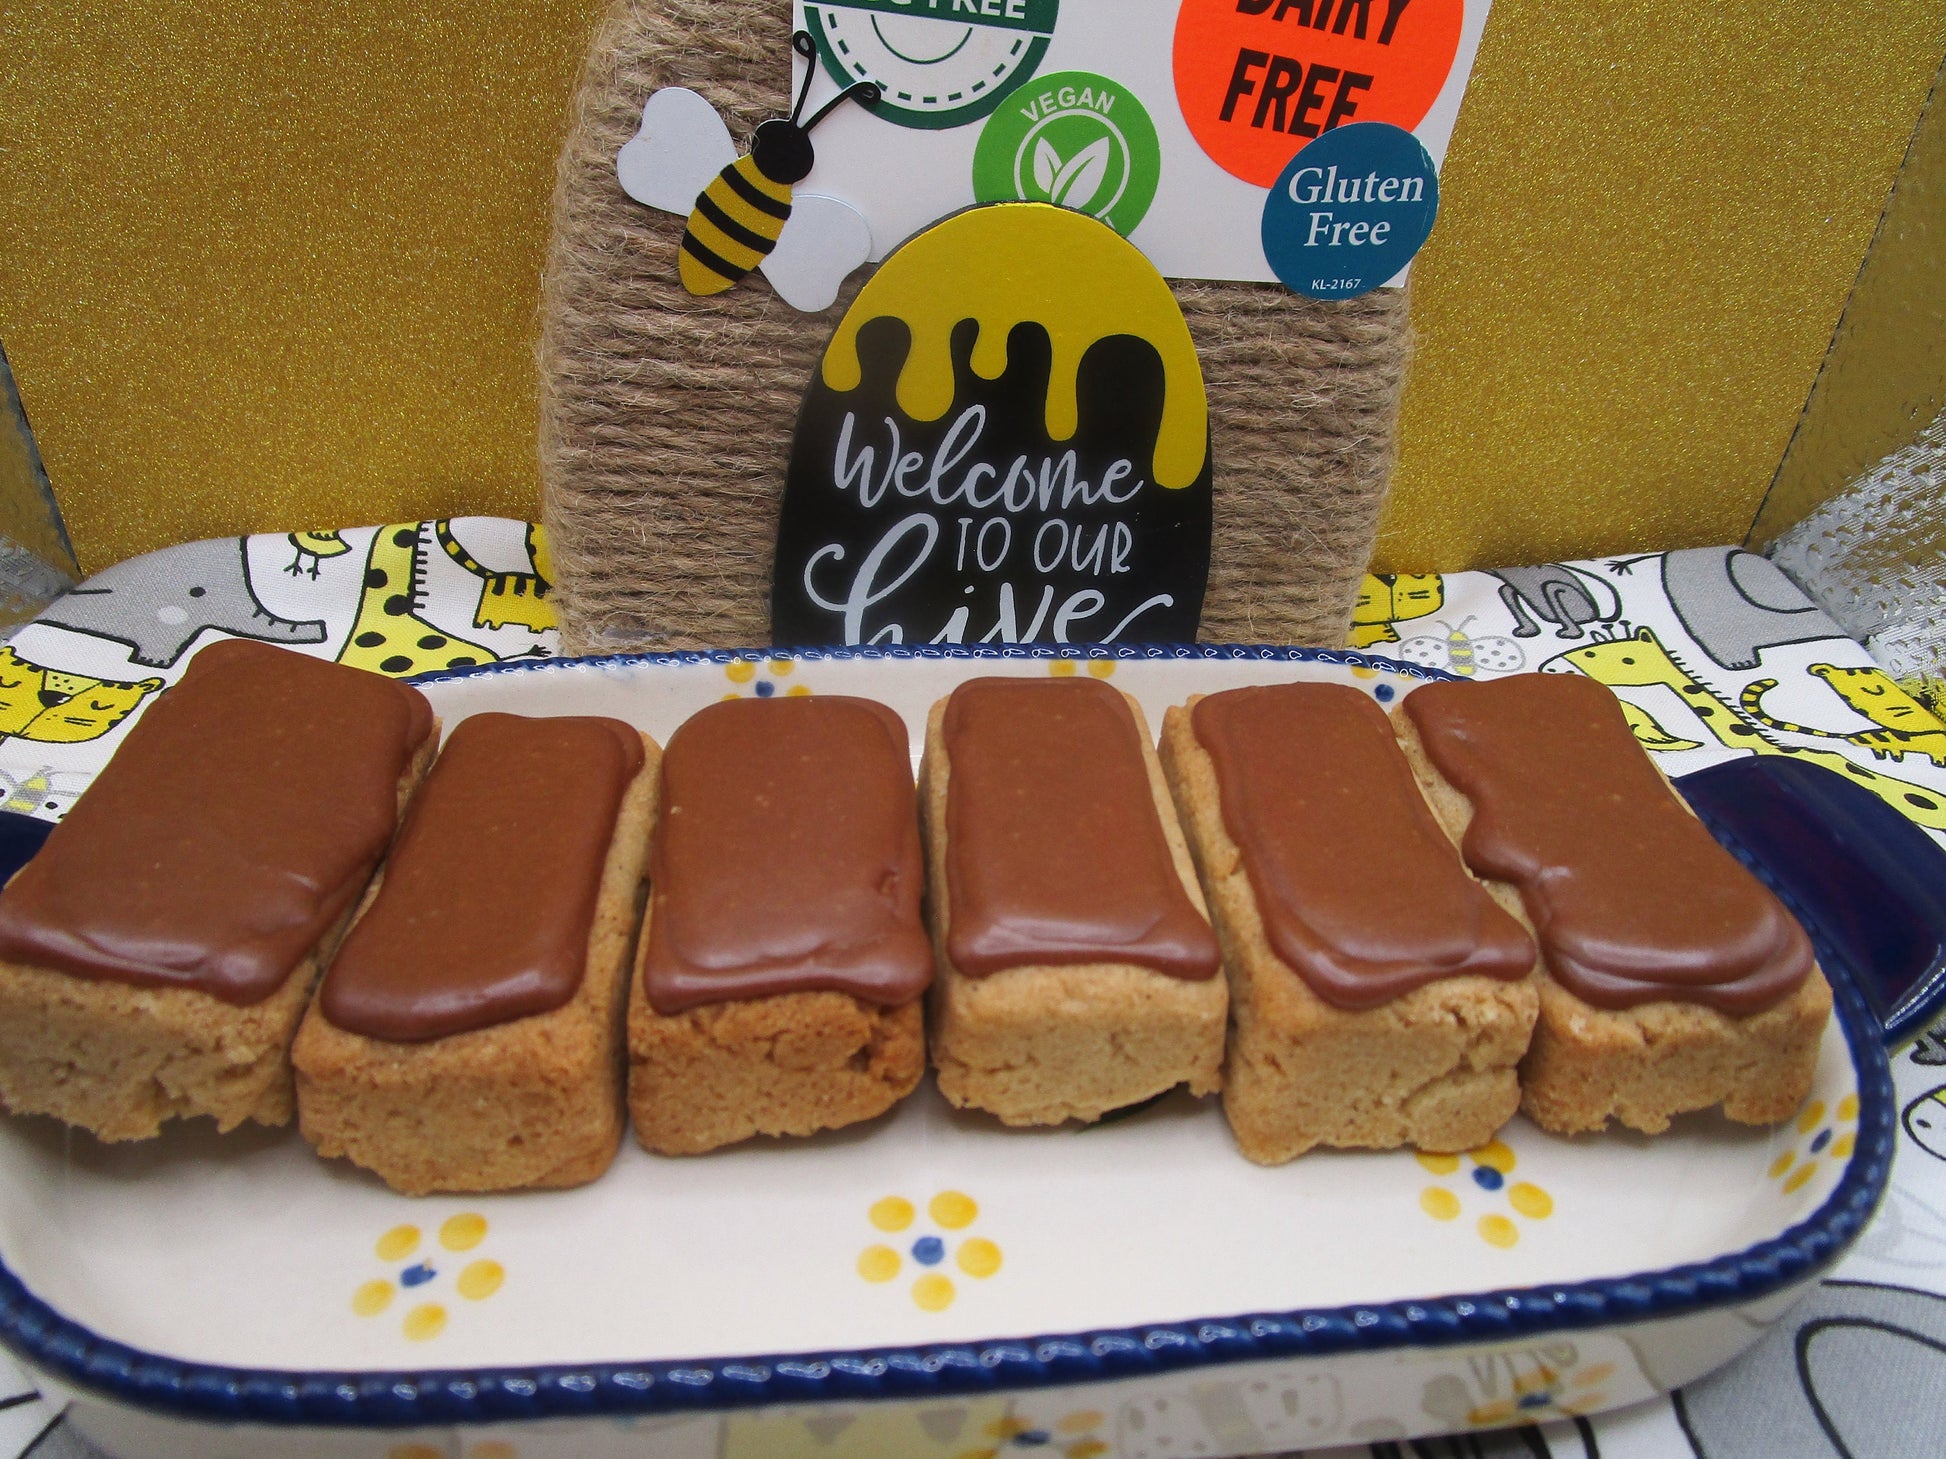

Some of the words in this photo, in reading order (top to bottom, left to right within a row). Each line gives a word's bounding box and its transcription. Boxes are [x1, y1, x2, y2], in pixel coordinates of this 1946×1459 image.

[929, 0, 1026, 20] EE
[1019, 86, 1116, 122] VEGAN
[1218, 47, 1375, 139] FREE
[1288, 165, 1424, 204] Gluten
[1303, 212, 1391, 247] Free
[1311, 278, 1362, 290] KL-2167
[834, 404, 1144, 514] Welcome
[956, 516, 1012, 573] TO
[1033, 518, 1134, 576] OUR
[803, 512, 1174, 645] hive
